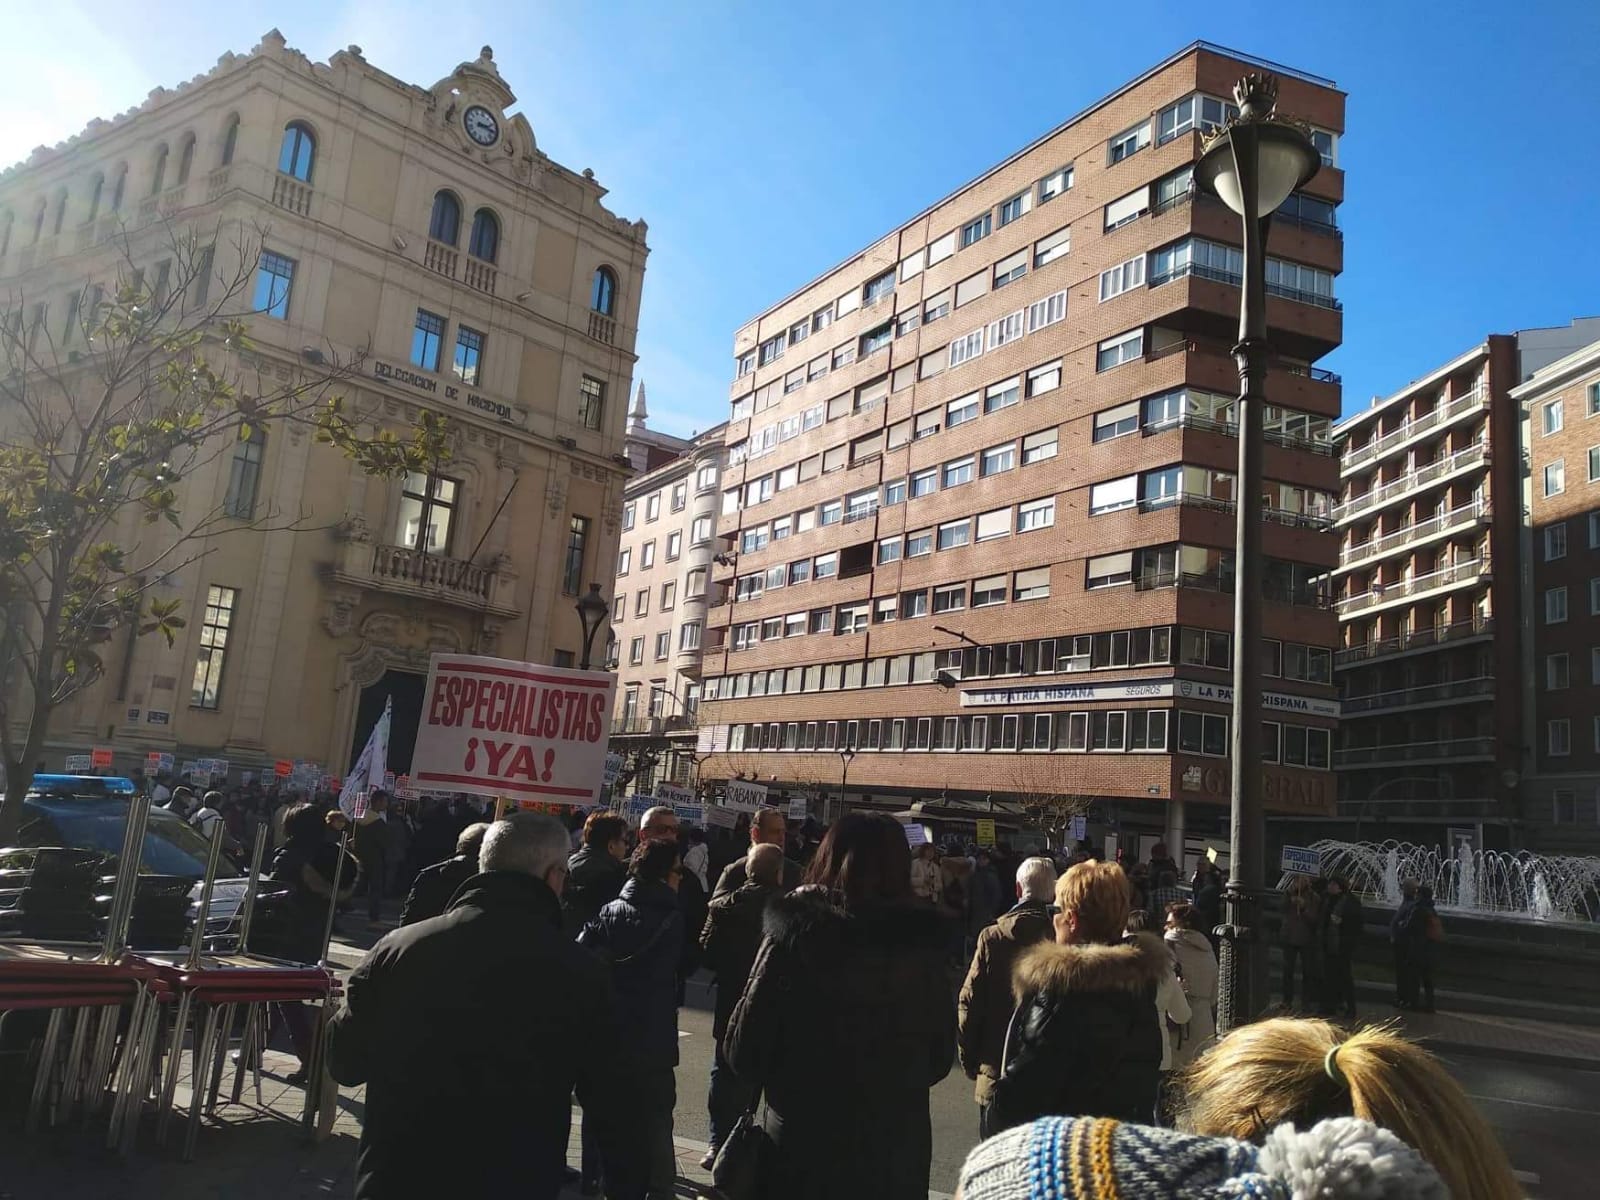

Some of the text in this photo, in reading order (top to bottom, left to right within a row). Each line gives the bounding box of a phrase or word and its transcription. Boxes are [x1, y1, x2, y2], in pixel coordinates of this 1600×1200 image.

[445, 385, 459, 400] DE
[467, 393, 511, 420] HACIENDA
[428, 675, 605, 744] ESPECIALISTAS
[983, 685, 1161, 704] LA PATRIA HISPANA SEGUROS
[1199, 686, 1213, 697] LA
[1262, 695, 1308, 711] HISPANA
[464, 737, 556, 783] ¡YA!
